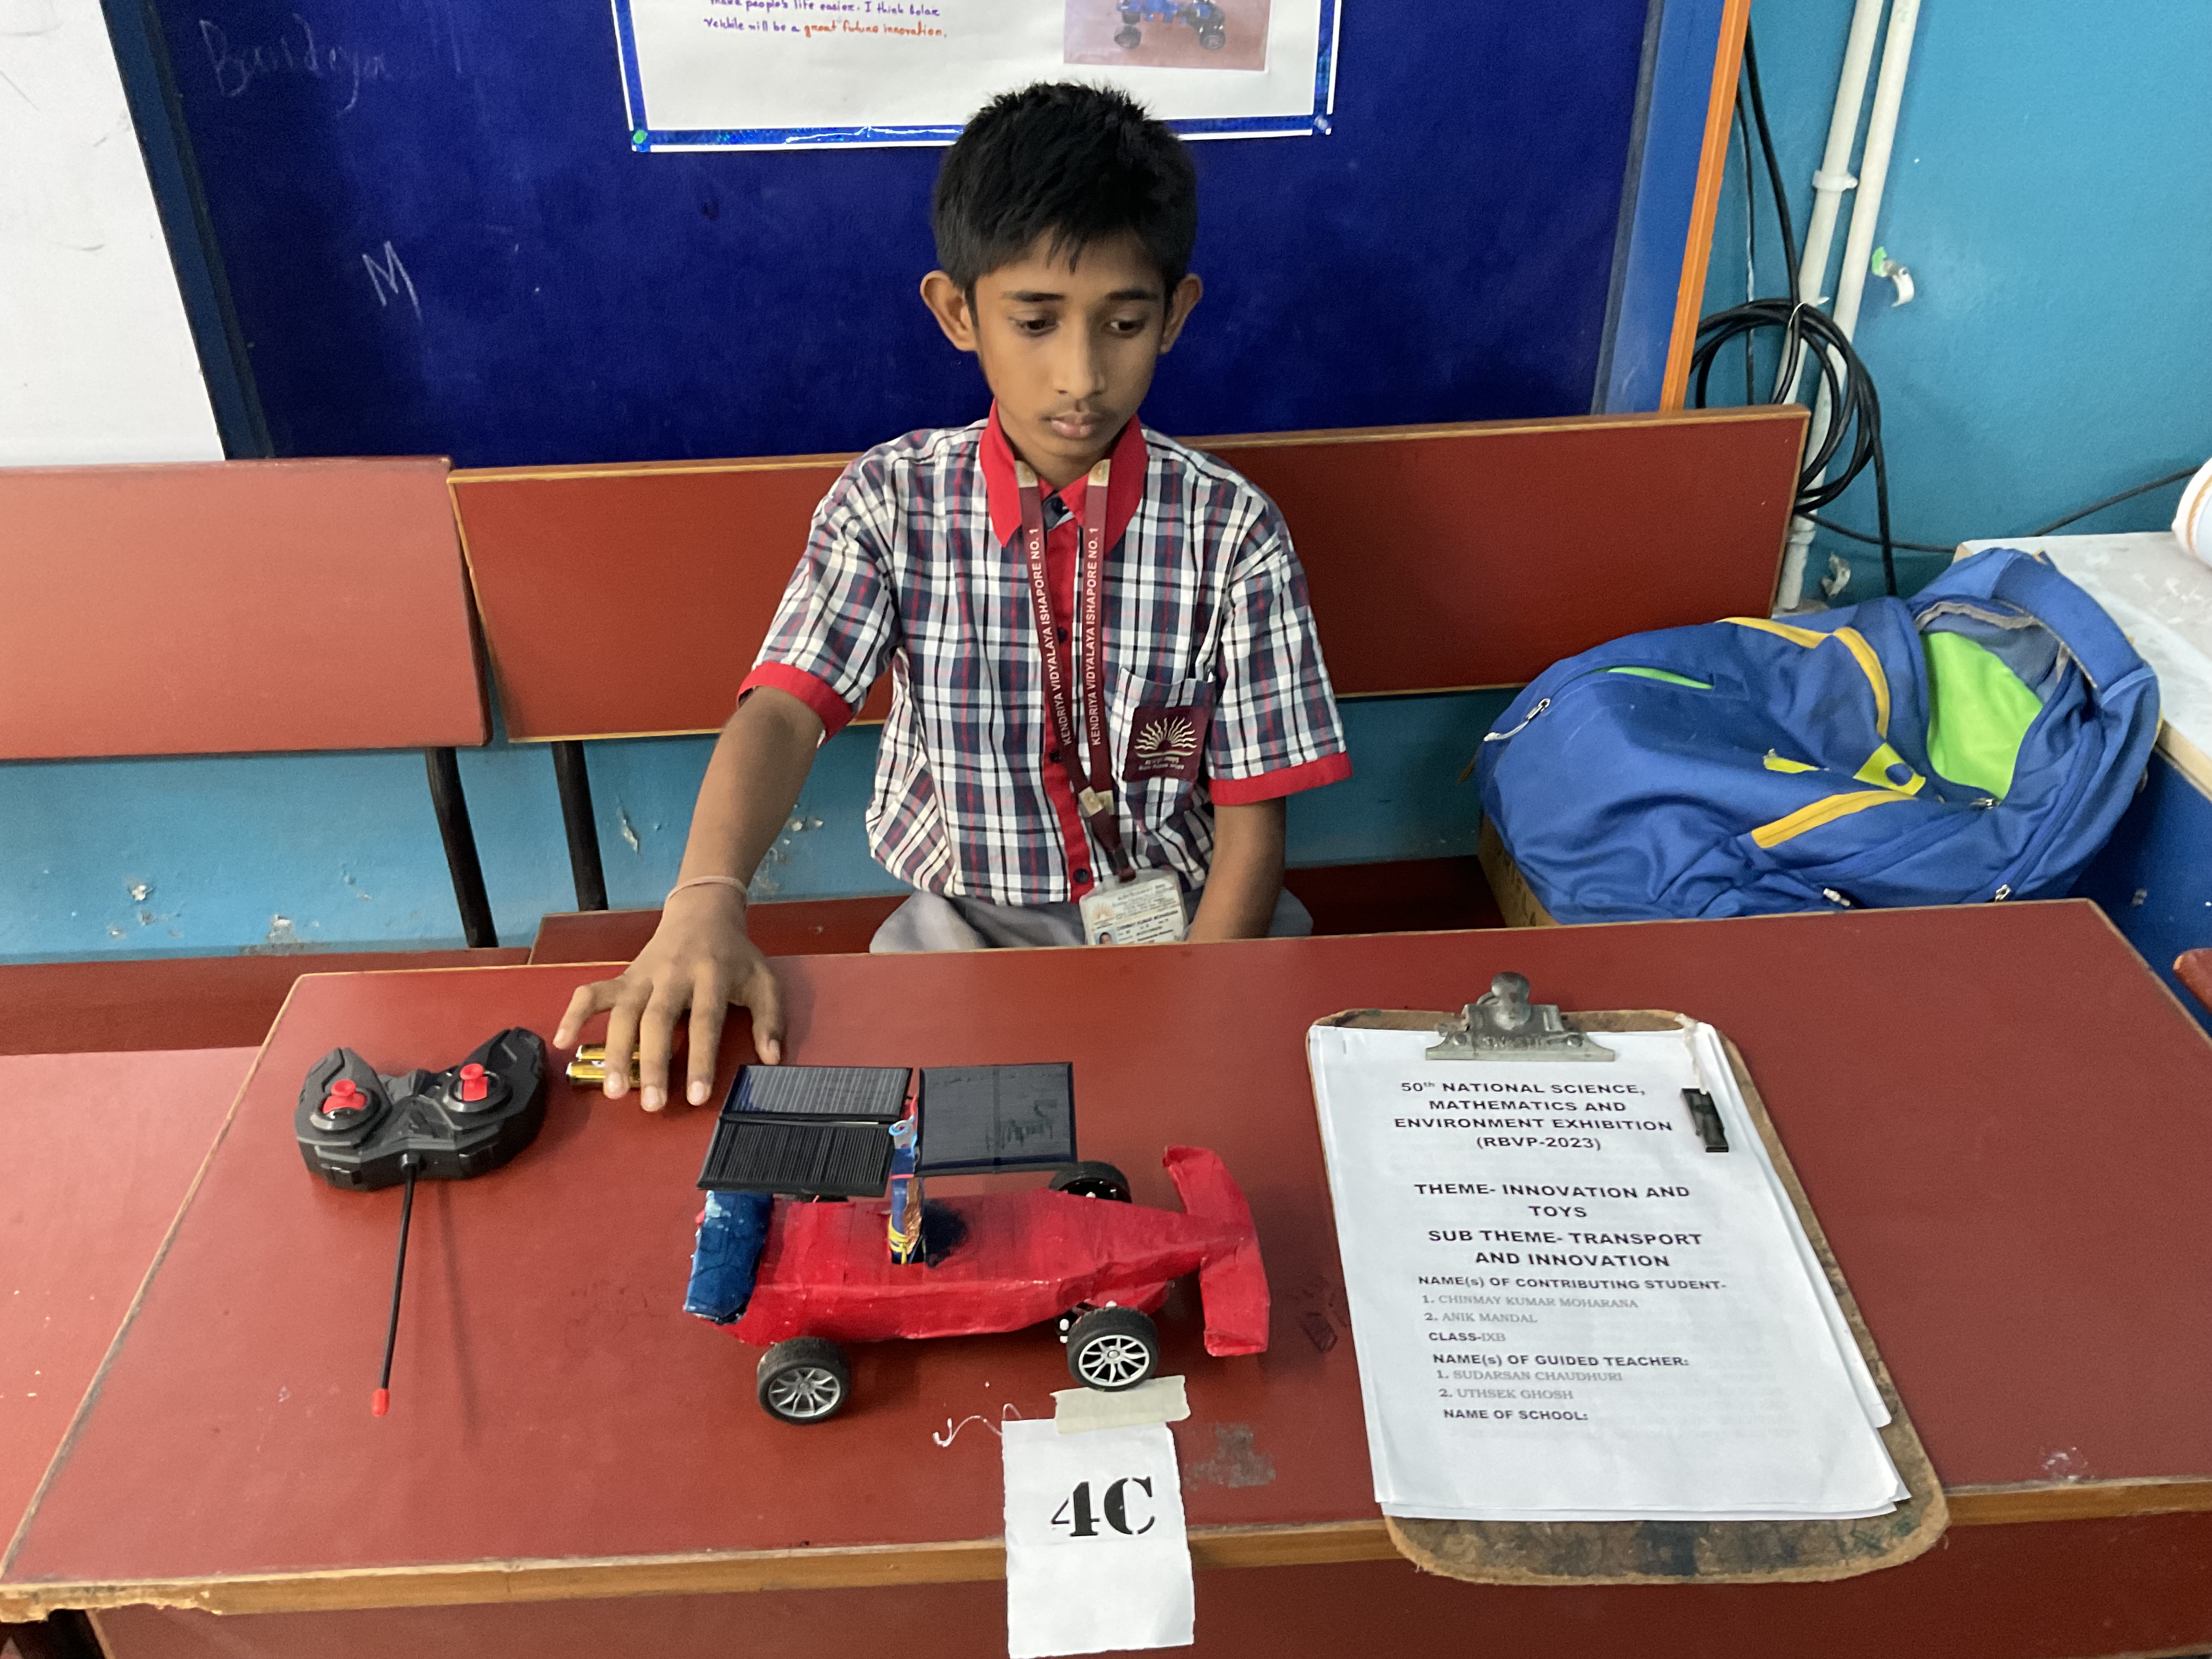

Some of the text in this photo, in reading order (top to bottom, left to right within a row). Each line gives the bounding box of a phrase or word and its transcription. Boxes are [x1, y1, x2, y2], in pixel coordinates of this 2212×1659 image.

[865, 1, 872, 13] I
[877, 1, 904, 14] think
[748, 20, 769, 32] will
[773, 21, 786, 32] be
[804, 19, 837, 38] great
[843, 19, 878, 33] future
[1030, 538, 1041, 560] NO.
[1088, 537, 1099, 558] NO.
[1032, 563, 1051, 625] ISHAPORE
[1086, 561, 1097, 625] ISHAPORE
[1042, 627, 1062, 692] VIDYALAYA
[1086, 627, 1097, 691] VIDYALAYA
[1053, 692, 1072, 747] KENDRIYA
[1087, 691, 1101, 746] KENDRIYA
[1442, 1082, 1545, 1093] NATIONAL
[1550, 1084, 1646, 1096] SCIENCE,
[1428, 1100, 1627, 1112] MATHEMATICS AND
[1393, 1118, 1673, 1131] ENVIRONMENT EXHIBITION
[1476, 1136, 1601, 1152] (RBVP-2023)
[1413, 1183, 1691, 1199] THEME- INNOVATION AND
[1527, 1205, 1588, 1218] TOYS
[1427, 1229, 1702, 1245] SUB THEME- TRANSPORT
[1475, 1251, 1671, 1267] AND INNOVATION
[1418, 1276, 1727, 1290] NAME(s) OF CONTRIBUTING STUDENT-
[1422, 1295, 1639, 1308] 1. CHINMAY KUMAR MOHARANA
[1424, 1312, 1538, 1323] 2. ANIK MANDAL
[1428, 1331, 1506, 1342] CLASS-IXB
[1432, 1353, 1690, 1367] NAME(s) OF GUIDED TEACHER:
[1436, 1369, 1623, 1381] 1. SUDARSAN CHAUDHURI
[1438, 1388, 1573, 1400] 2. UTHSEK GHOSH
[1443, 1409, 1589, 1421] NAME OF SCHOOL:
[1051, 1476, 1155, 1537] 4C
